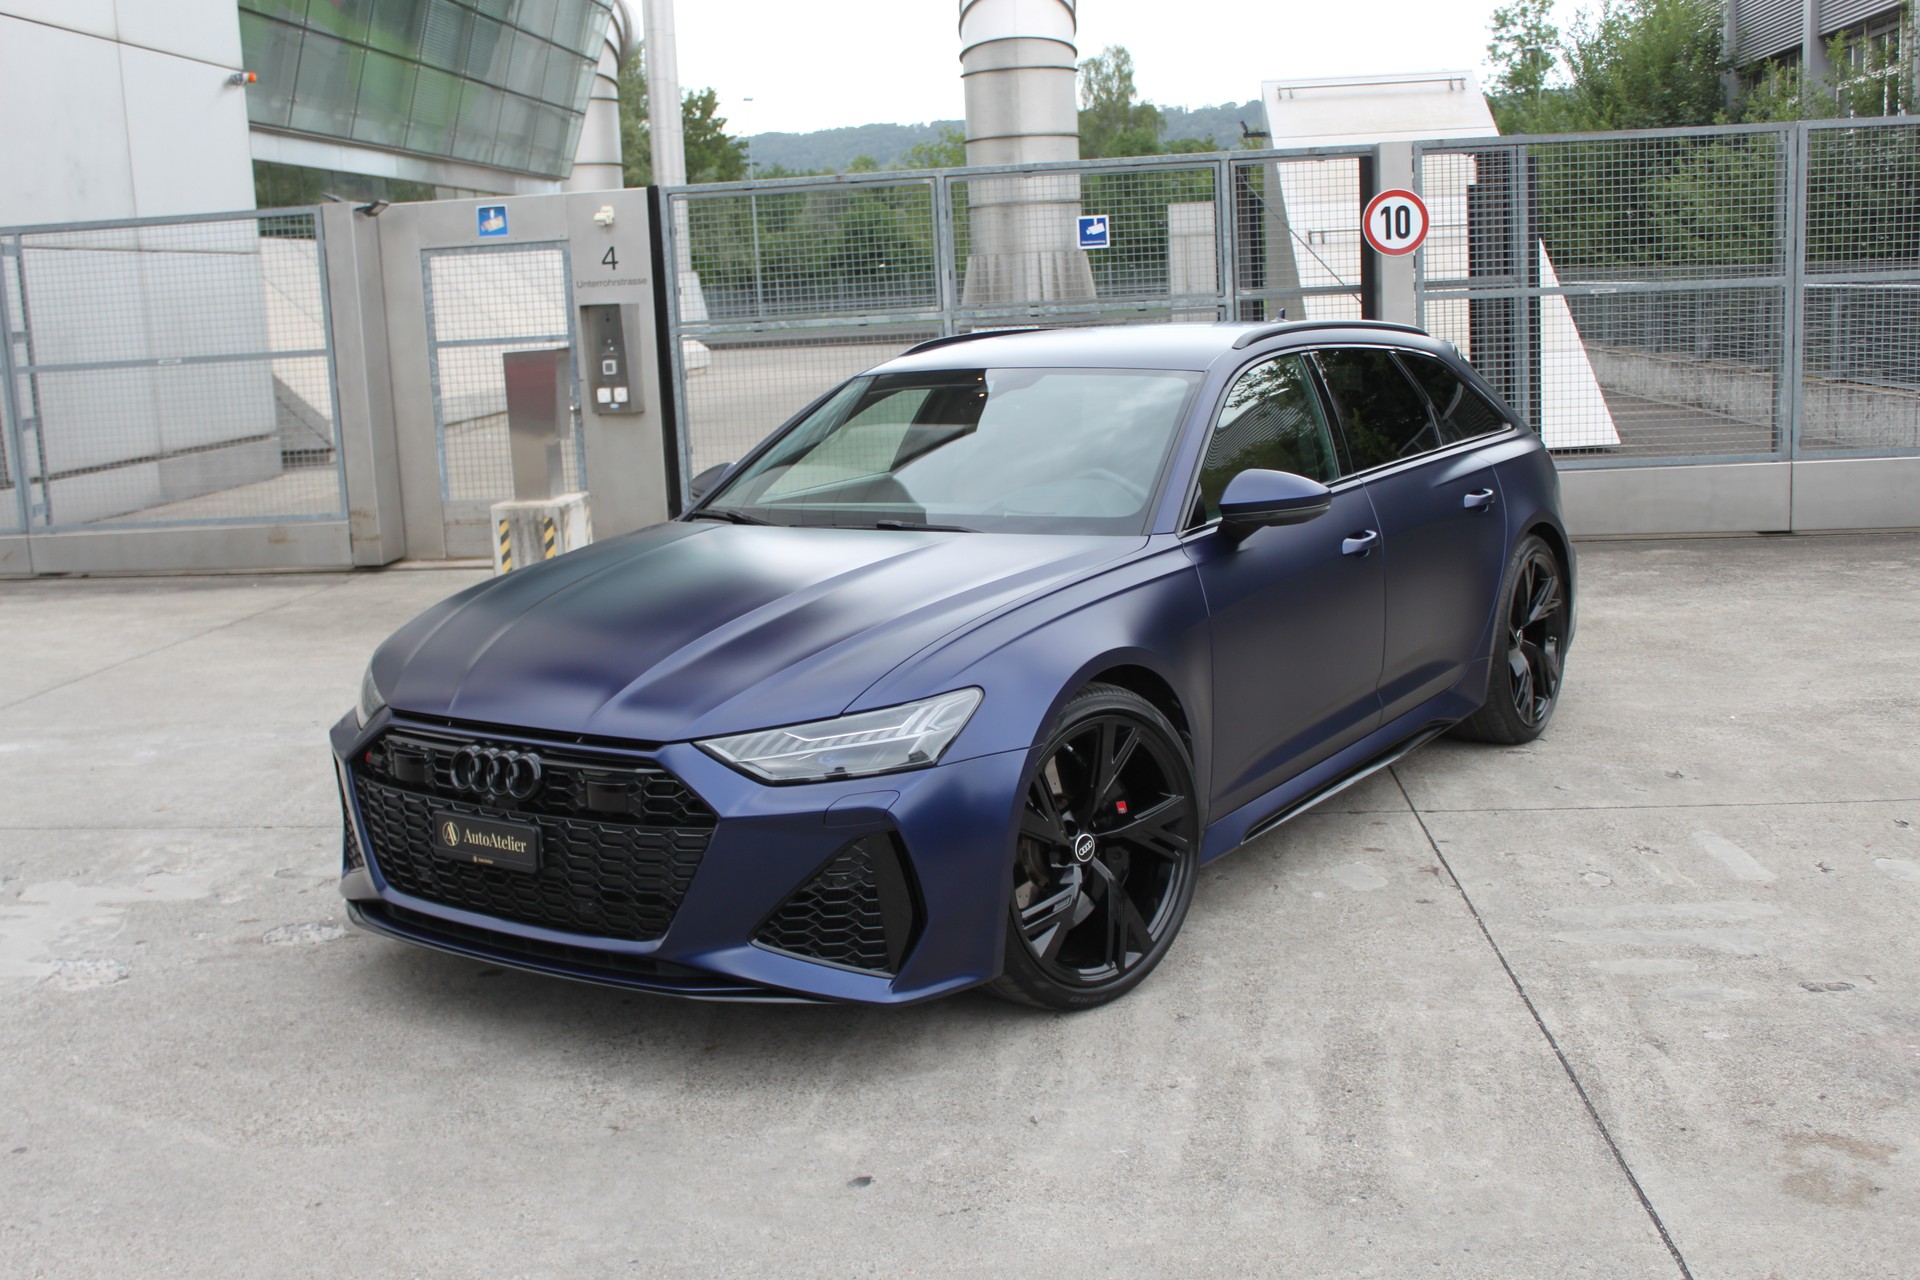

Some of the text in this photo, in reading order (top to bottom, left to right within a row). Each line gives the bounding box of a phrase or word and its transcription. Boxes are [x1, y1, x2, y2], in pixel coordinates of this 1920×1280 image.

[1380, 205, 1411, 240] 10
[601, 246, 619, 270] 4
[575, 278, 648, 289] Unterrohrstrasse
[463, 828, 527, 853] AutoAtelier
